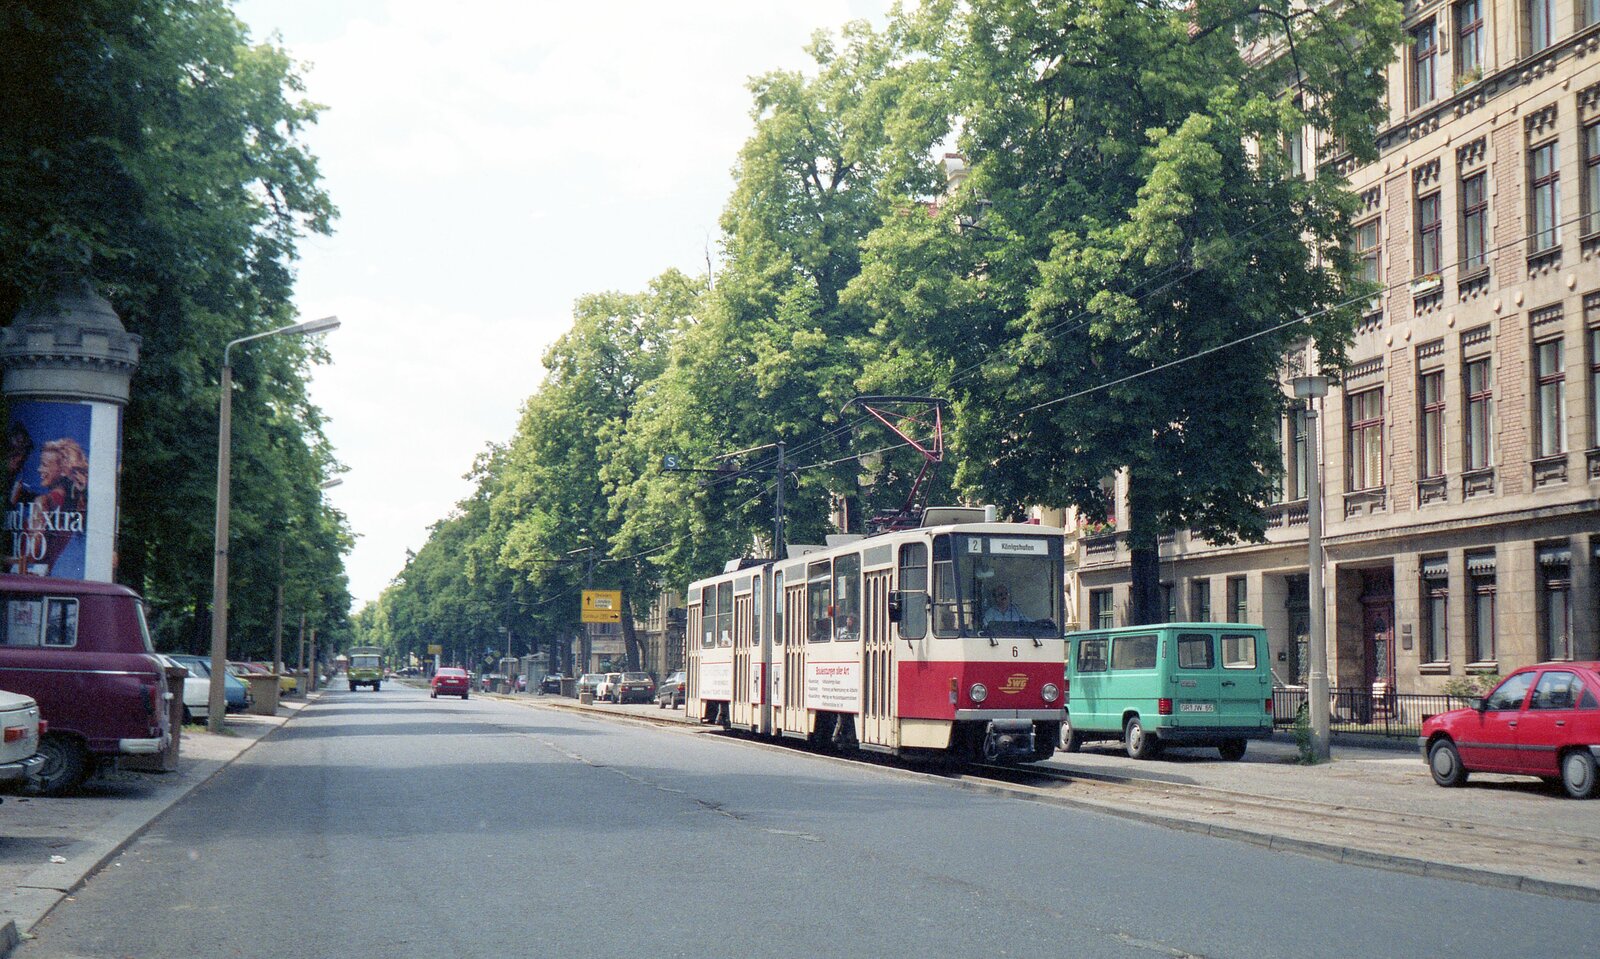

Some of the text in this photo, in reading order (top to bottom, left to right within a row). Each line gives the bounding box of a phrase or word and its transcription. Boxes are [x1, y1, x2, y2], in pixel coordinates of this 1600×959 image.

[668, 457, 675, 467] S
[27, 502, 83, 532] Extra
[13, 531, 47, 560] 100
[972, 540, 978, 551] 2
[1012, 646, 1018, 657] 6
